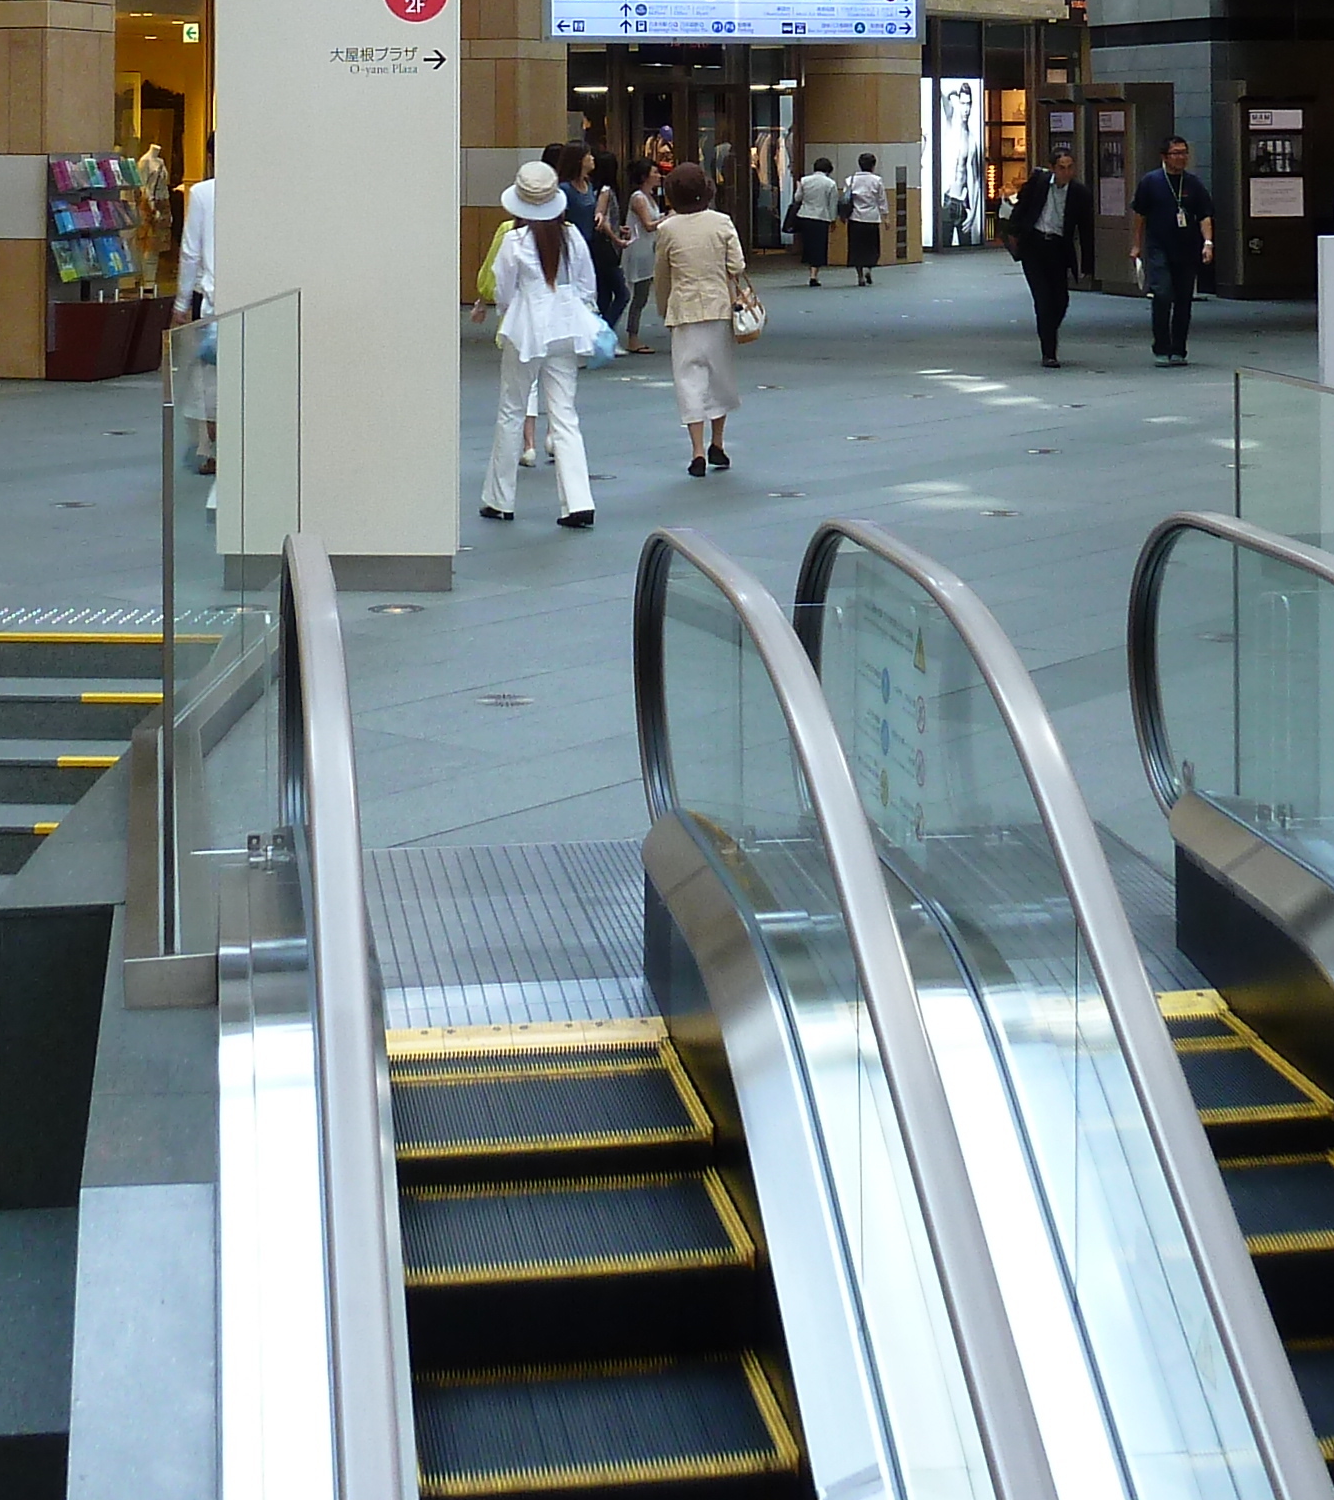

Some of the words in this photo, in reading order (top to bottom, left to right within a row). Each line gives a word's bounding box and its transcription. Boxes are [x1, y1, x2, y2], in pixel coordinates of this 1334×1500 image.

[329, 46, 419, 63] 大屋根プラザ
[349, 63, 389, 77] O-yane
[392, 63, 418, 74] Plaza
